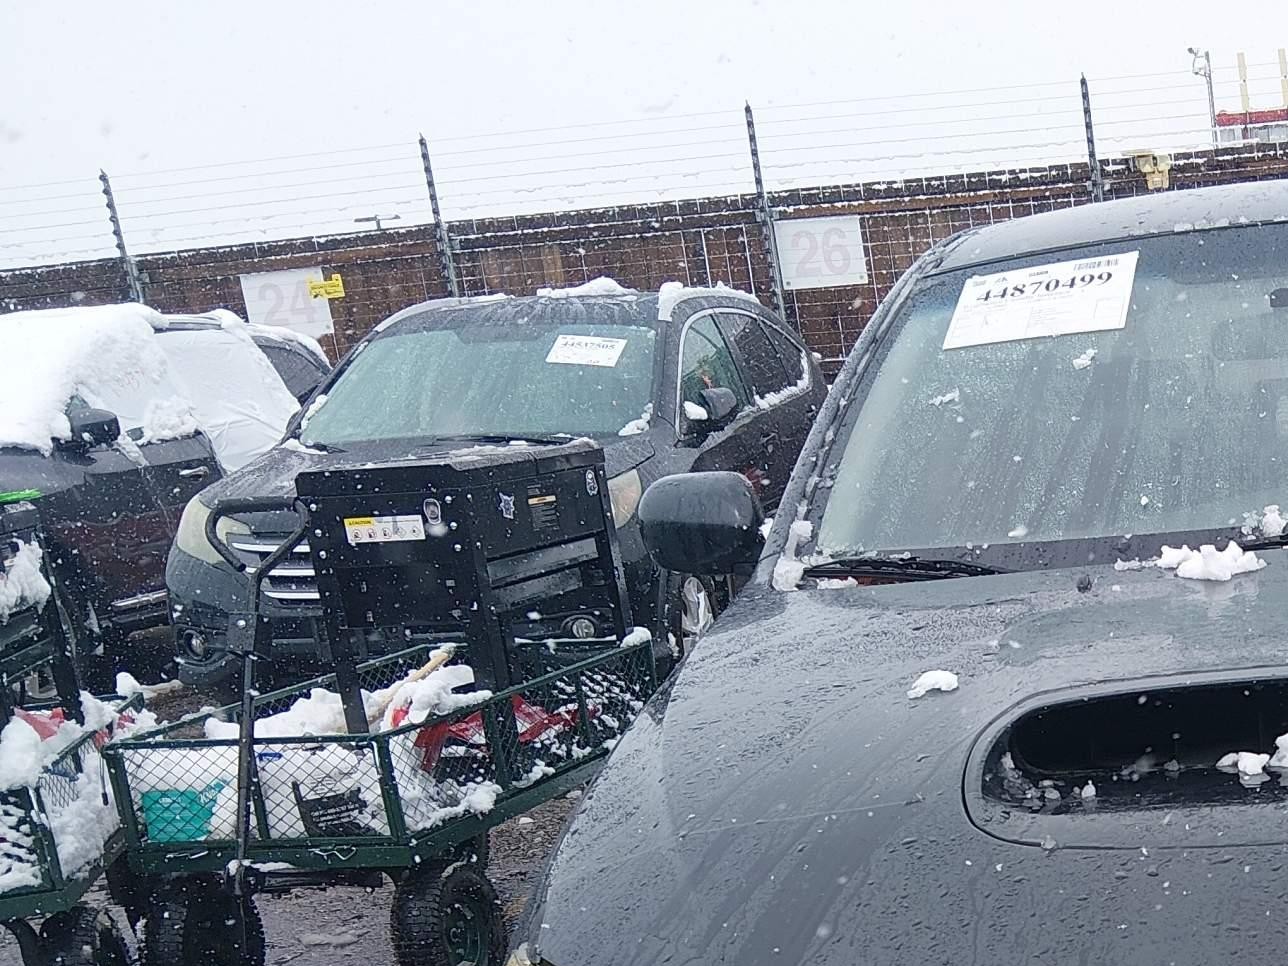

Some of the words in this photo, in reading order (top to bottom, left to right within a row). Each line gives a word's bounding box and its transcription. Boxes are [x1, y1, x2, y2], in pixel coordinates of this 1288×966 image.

[791, 227, 851, 277] 26
[258, 279, 317, 325] 24
[977, 271, 1113, 302] 44870499
